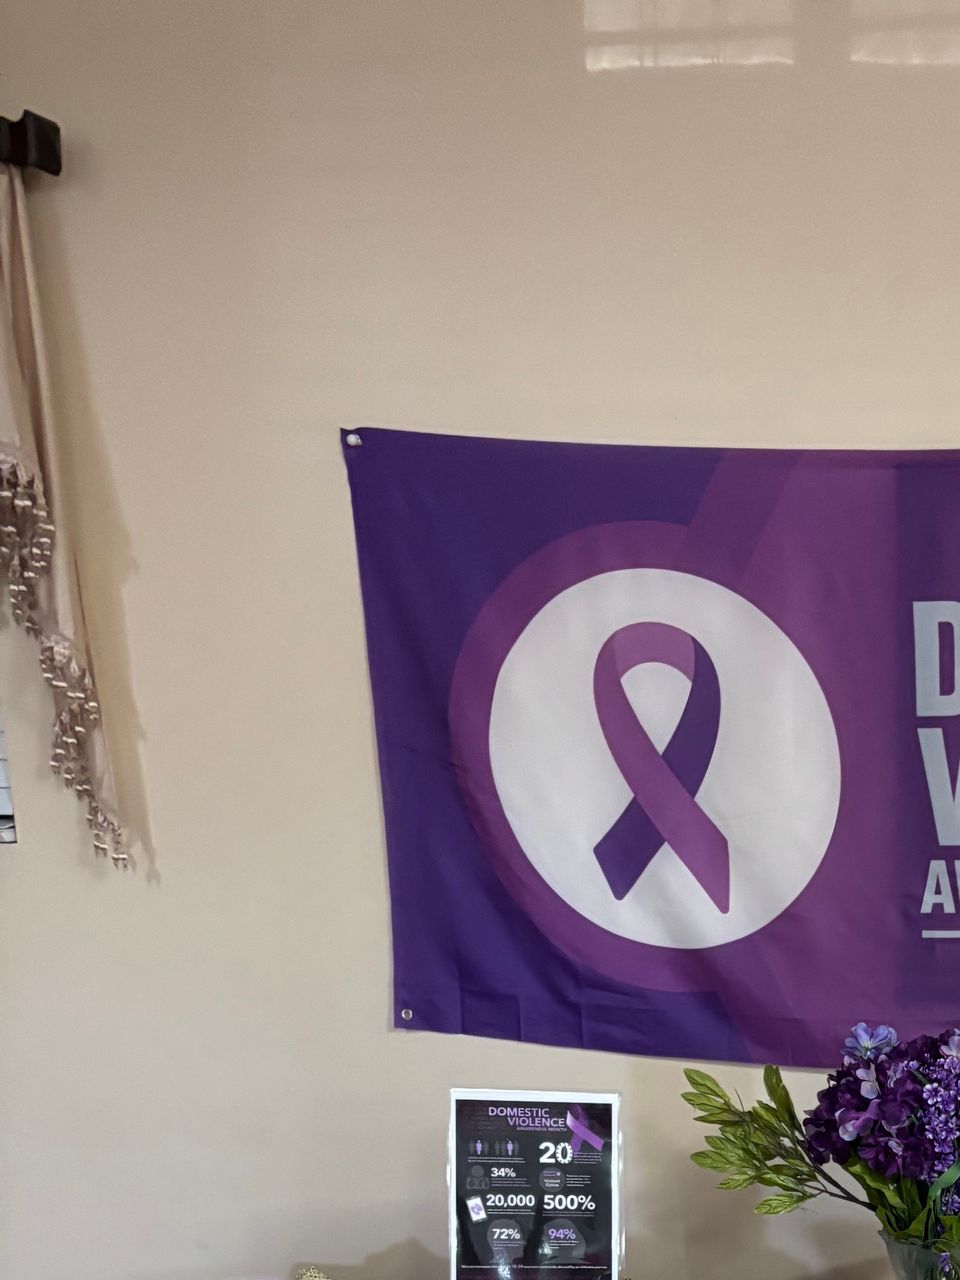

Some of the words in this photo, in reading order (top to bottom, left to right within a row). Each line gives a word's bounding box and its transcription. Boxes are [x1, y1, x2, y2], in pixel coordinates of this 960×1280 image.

[488, 1107, 549, 1117] DOMESTIC
[508, 1117, 565, 1127] VIOLENCE
[539, 1142, 573, 1164] 20
[491, 1168, 516, 1177] 34%
[486, 1194, 535, 1208] 20,000
[543, 1195, 595, 1210] 500%
[492, 1229, 520, 1239] 72%
[548, 1229, 576, 1239] 94%
